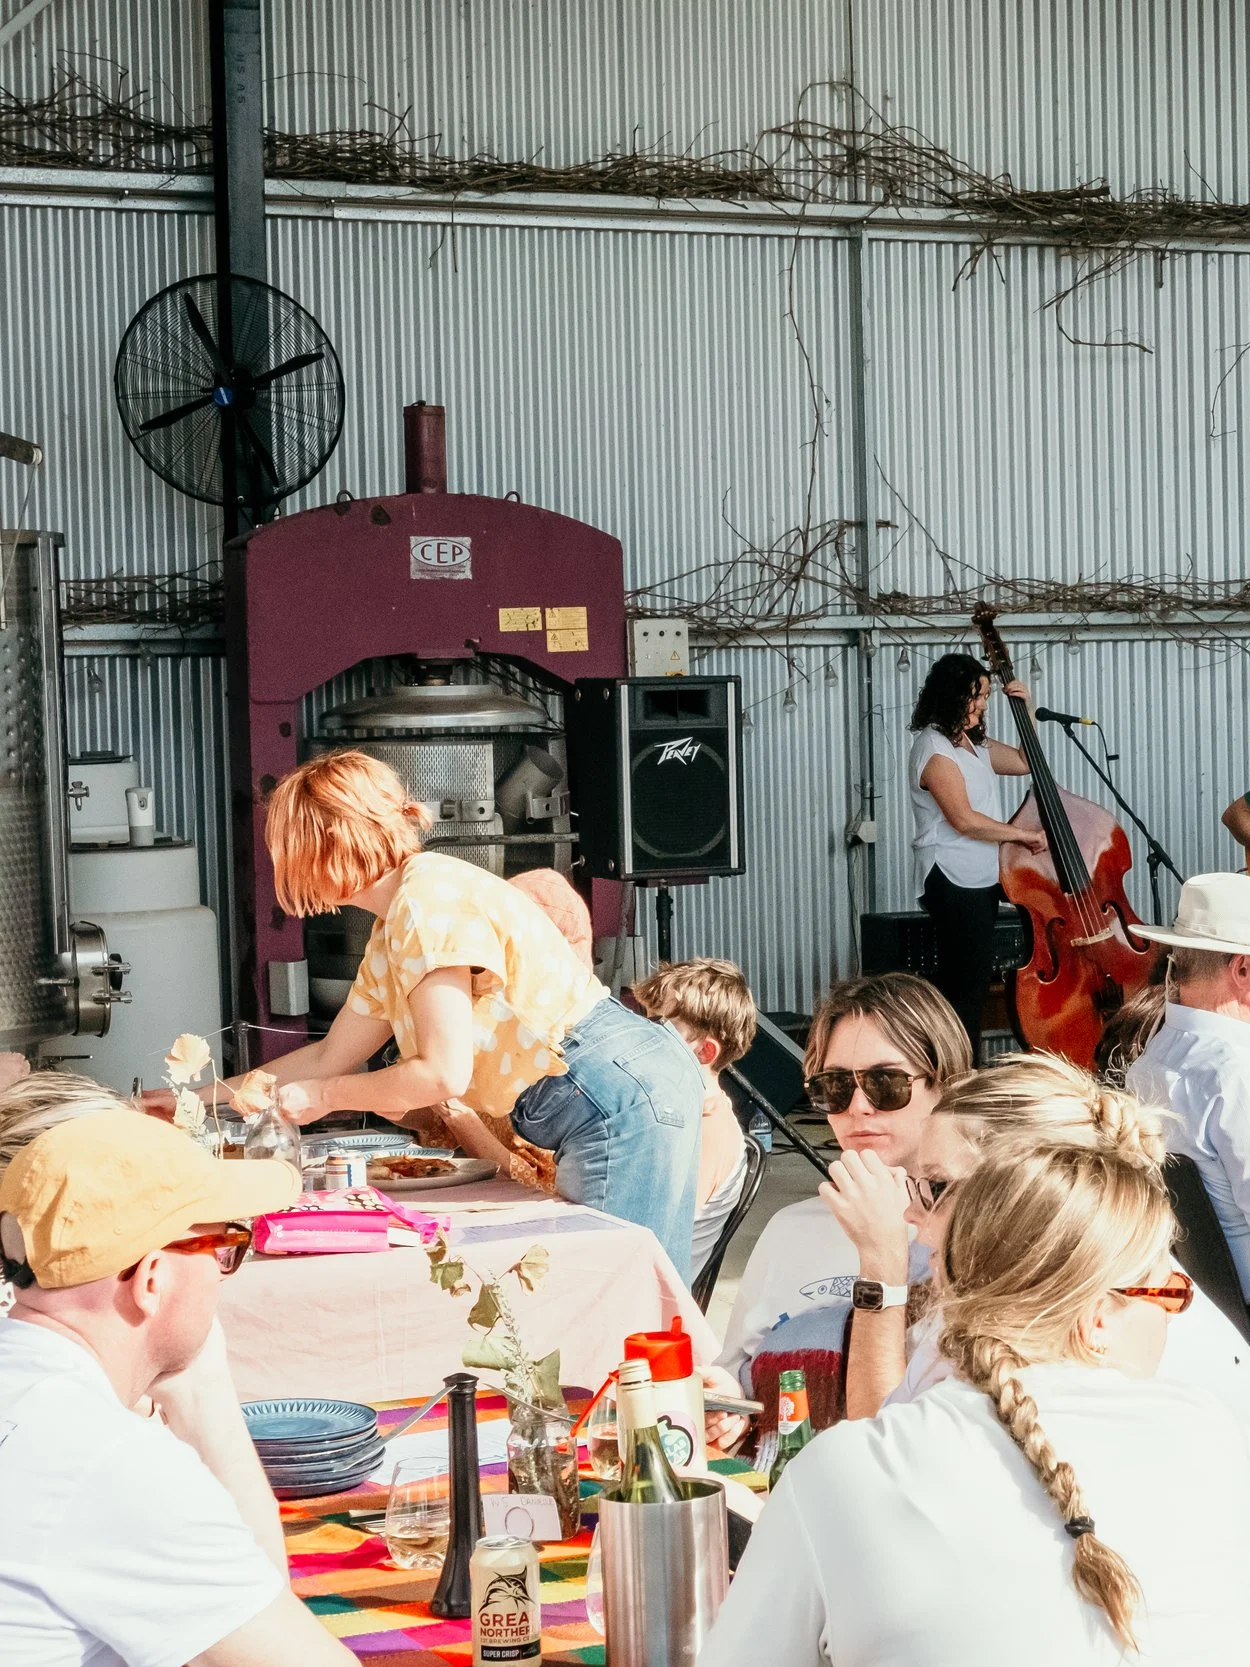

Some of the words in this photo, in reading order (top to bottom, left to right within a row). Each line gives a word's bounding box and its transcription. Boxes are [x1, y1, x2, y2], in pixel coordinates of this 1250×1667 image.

[420, 542, 463, 564] CEP
[653, 736, 702, 765] PEAVEY
[480, 1627, 531, 1638] NORTHER
[483, 1649, 501, 1658] SUPER
[501, 1649, 520, 1658] CRISP
